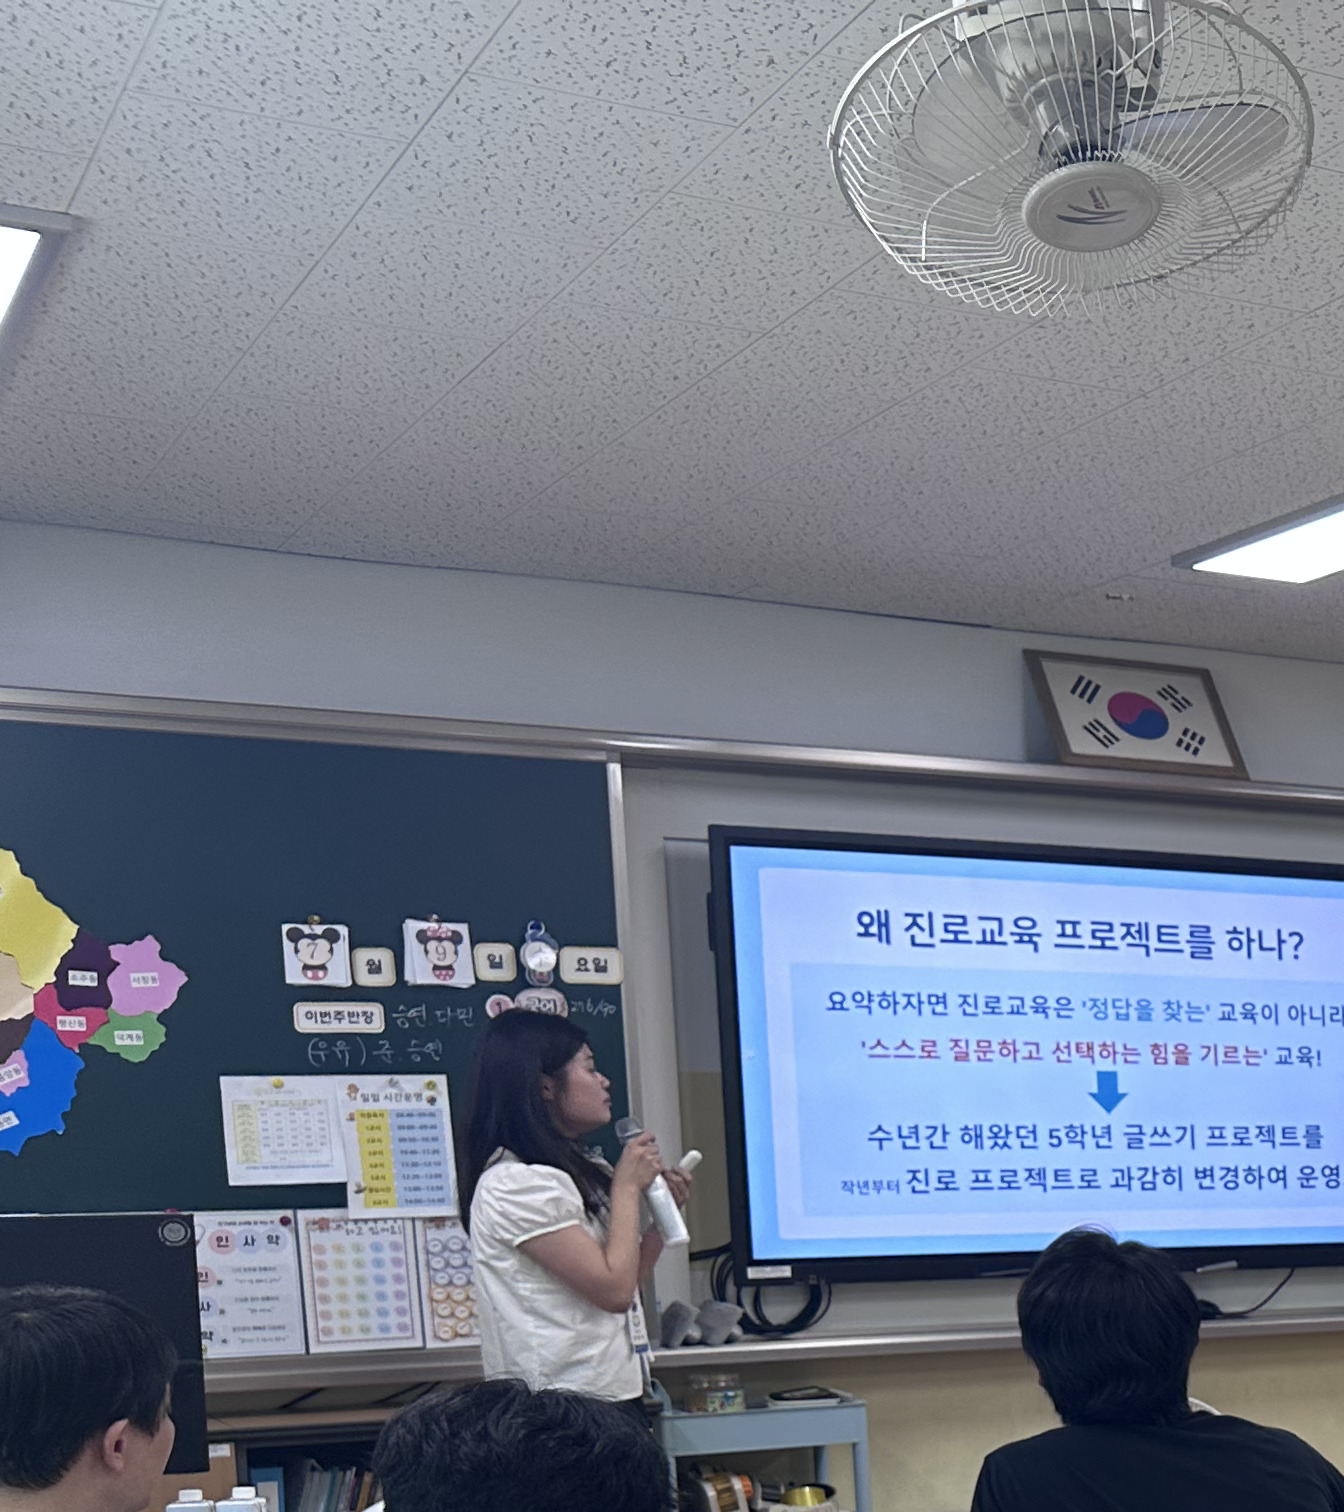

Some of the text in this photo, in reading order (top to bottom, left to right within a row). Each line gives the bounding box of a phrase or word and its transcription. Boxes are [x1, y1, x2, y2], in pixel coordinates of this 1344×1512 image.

[857, 909, 1304, 961] 왜 진로교육 프로젝트를 하나?
[307, 941, 608, 975] 7 월 9 일 요일
[304, 1008, 374, 1026] 이번주반장
[827, 990, 949, 1017] 요약하자면
[957, 992, 1075, 1020] 진로교육은
[1082, 998, 1155, 1022] '정답을
[1162, 1000, 1211, 1023] 찾는'
[1218, 1002, 1280, 1025] 교육이
[861, 1038, 1322, 1068] '스스로 질문하고 선택하는 힘을 기르는' 교육!
[867, 1123, 1325, 1151] 수년간 해왔던 5학년 글쓰기 프로젝트를
[840, 1178, 901, 1195] 작년부터
[905, 1167, 960, 1194] 진로
[969, 1166, 1102, 1193] 프로젝트로
[1110, 1165, 1184, 1192] 과감히
[1194, 1165, 1288, 1191] 변경하여
